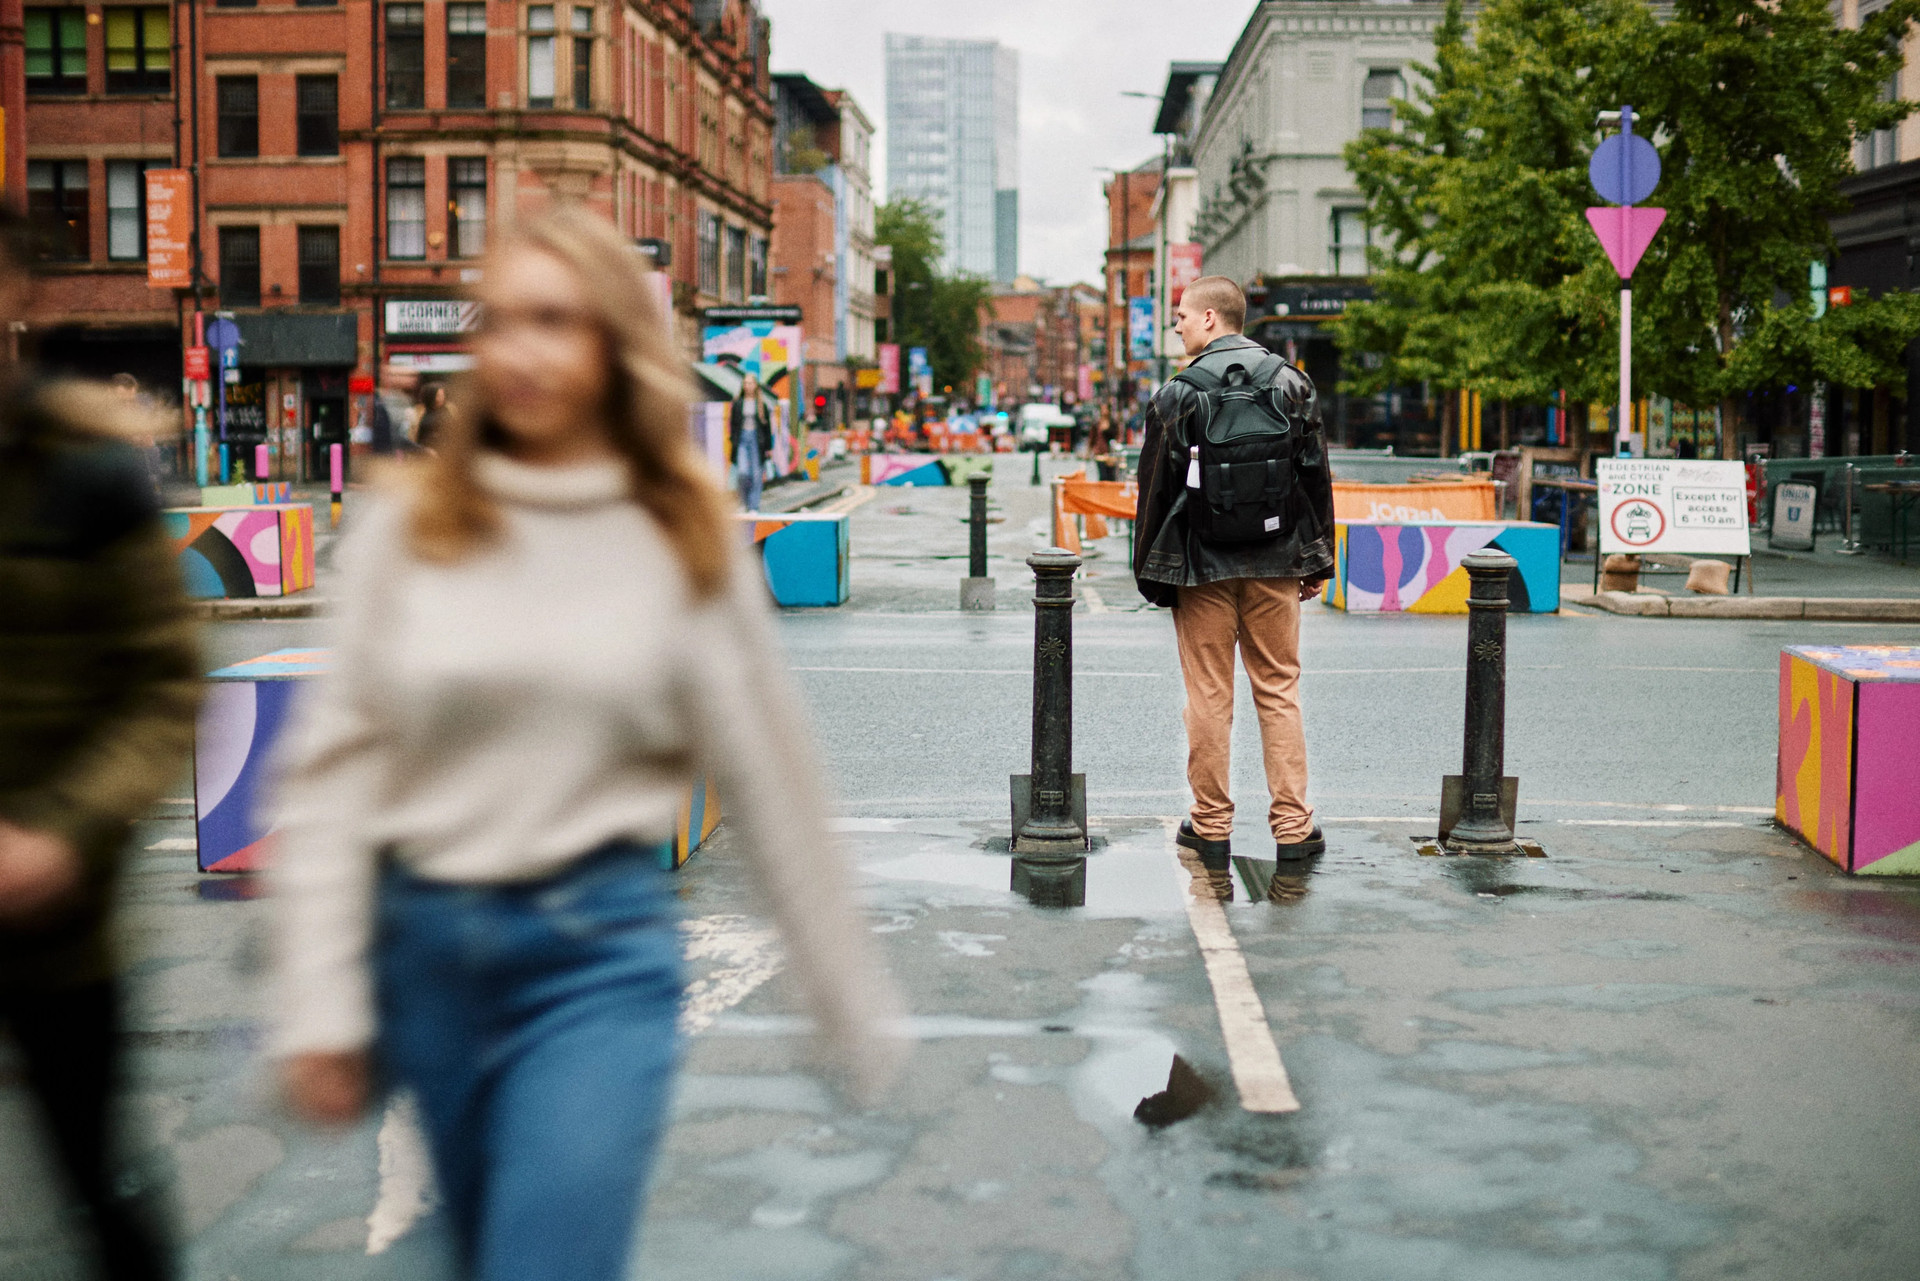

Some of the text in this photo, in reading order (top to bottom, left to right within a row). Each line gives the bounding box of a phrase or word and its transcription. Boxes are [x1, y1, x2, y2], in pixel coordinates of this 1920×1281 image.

[407, 303, 459, 317] CORNER
[1602, 463, 1670, 472] PEDESTRIAN
[1630, 473, 1664, 481] CYCLE
[1613, 483, 1662, 495] ZONE
[1676, 491, 1737, 502] Except for
[1688, 505, 1728, 513] access
[1681, 514, 1689, 523] 6
